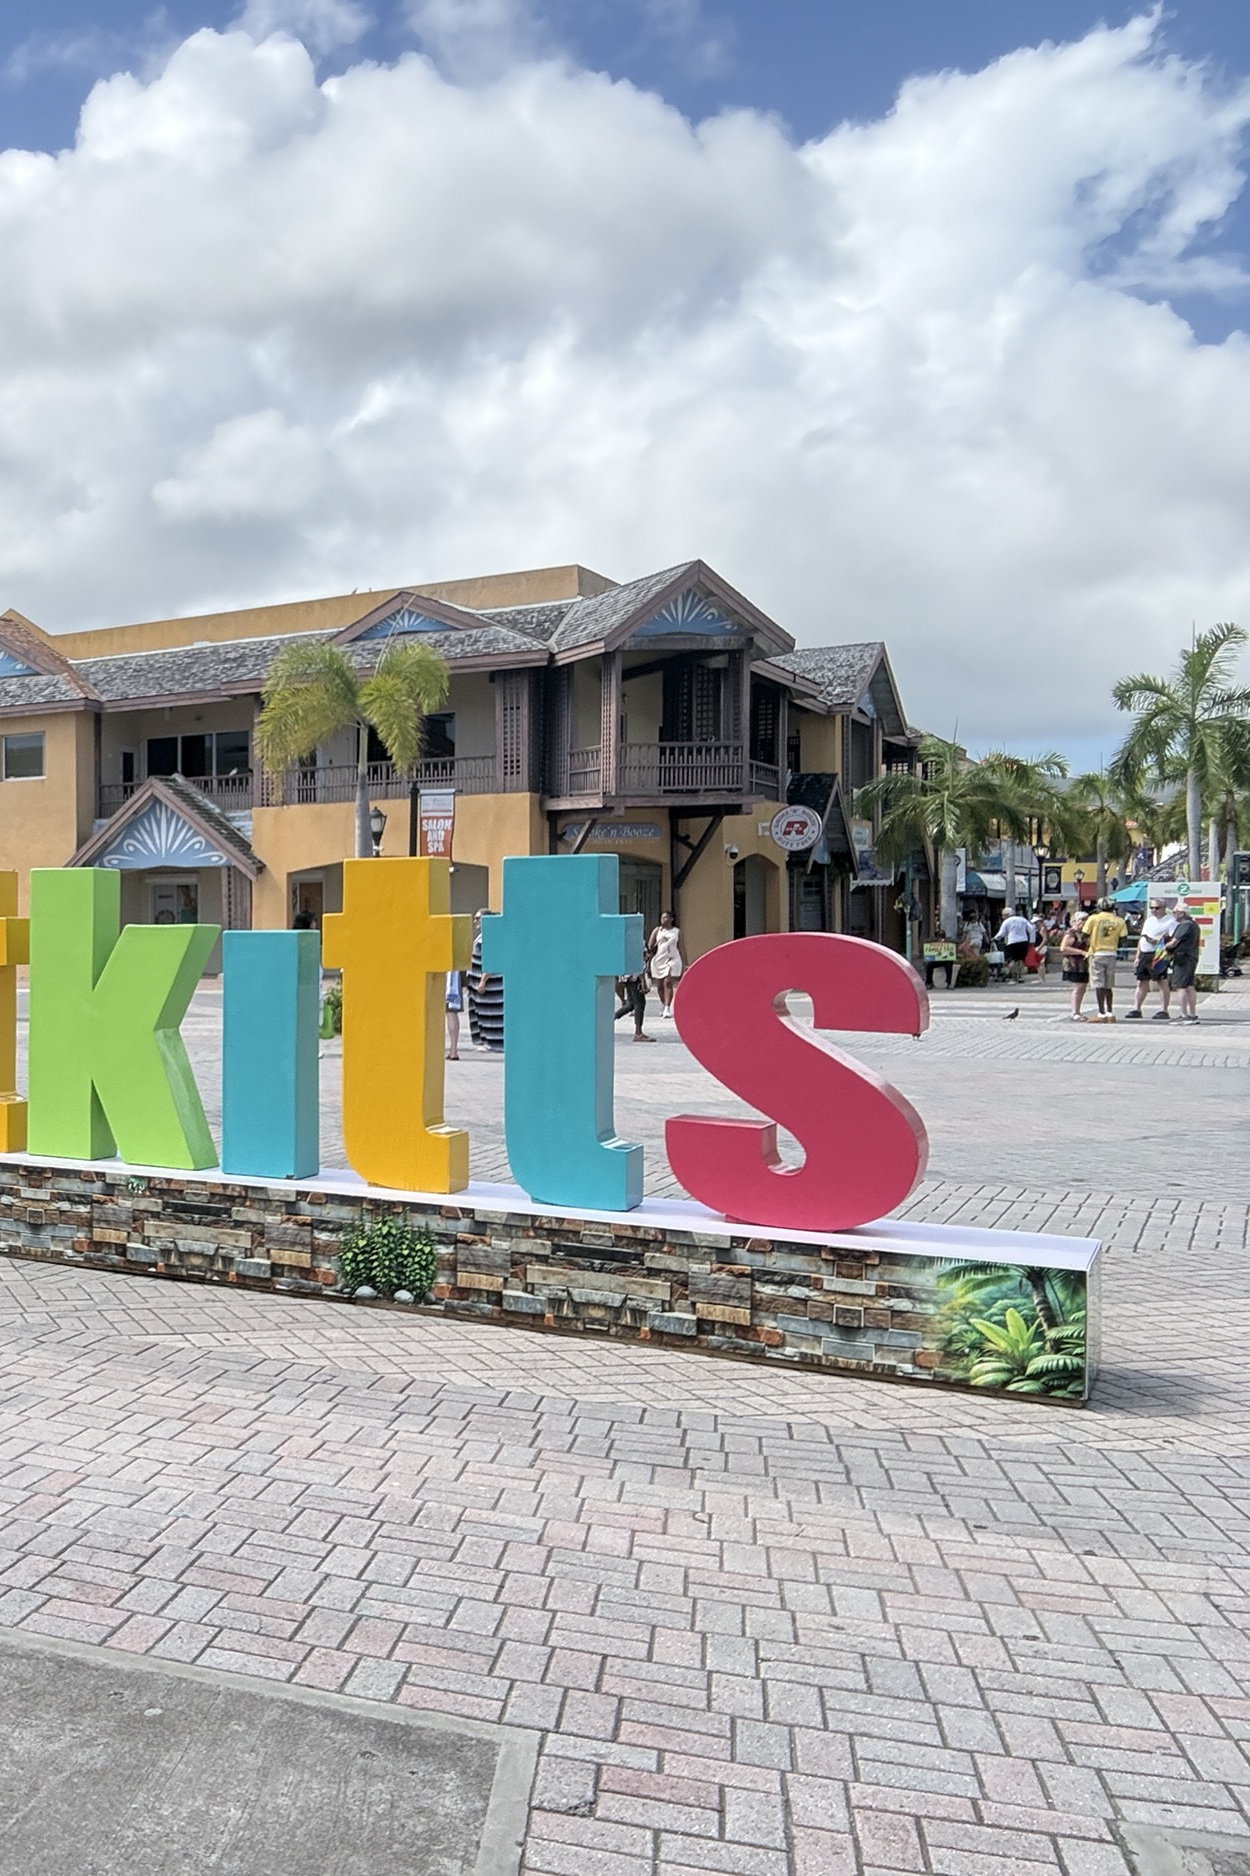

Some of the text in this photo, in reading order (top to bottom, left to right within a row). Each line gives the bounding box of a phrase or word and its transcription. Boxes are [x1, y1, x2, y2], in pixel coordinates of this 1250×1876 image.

[422, 819, 452, 831] SALON
[427, 830, 445, 842] AND
[427, 841, 445, 854] SPA
